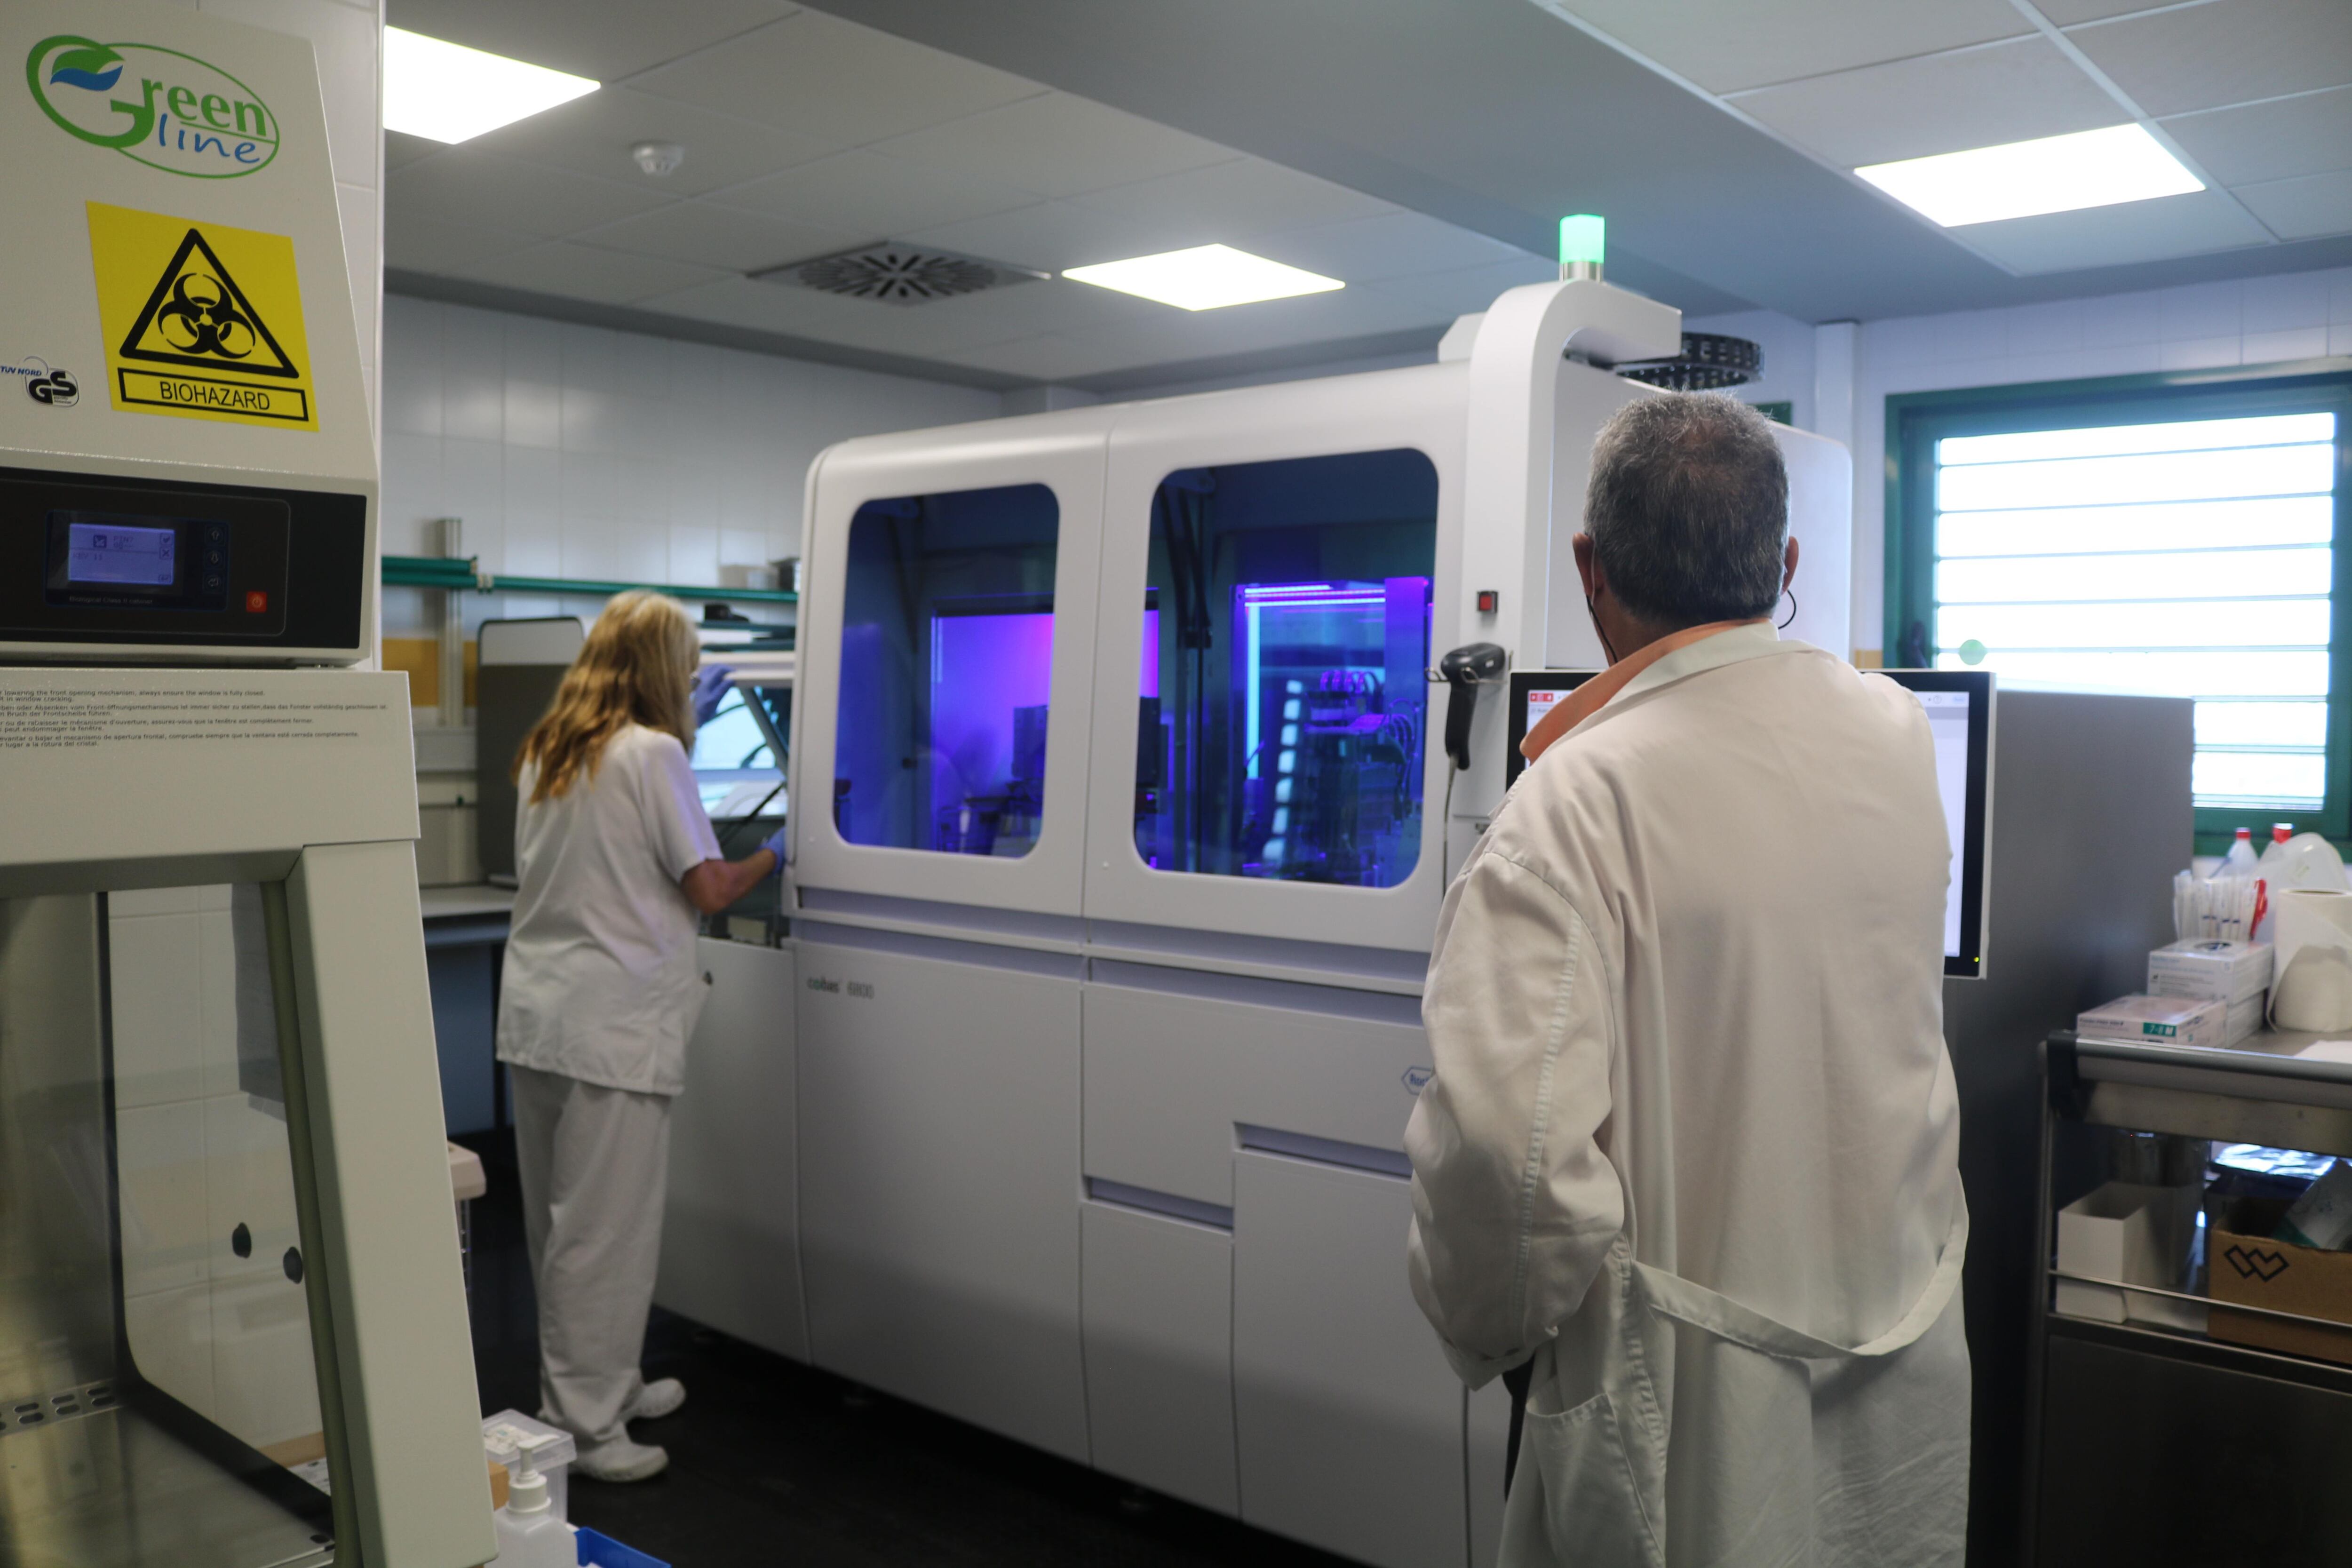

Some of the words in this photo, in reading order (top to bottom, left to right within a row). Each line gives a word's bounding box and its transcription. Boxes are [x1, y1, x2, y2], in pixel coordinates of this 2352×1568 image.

[159, 113, 260, 164] line
[18, 368, 42, 376] NORD
[28, 371, 77, 404] GS
[160, 381, 270, 410] BIOHAZARD
